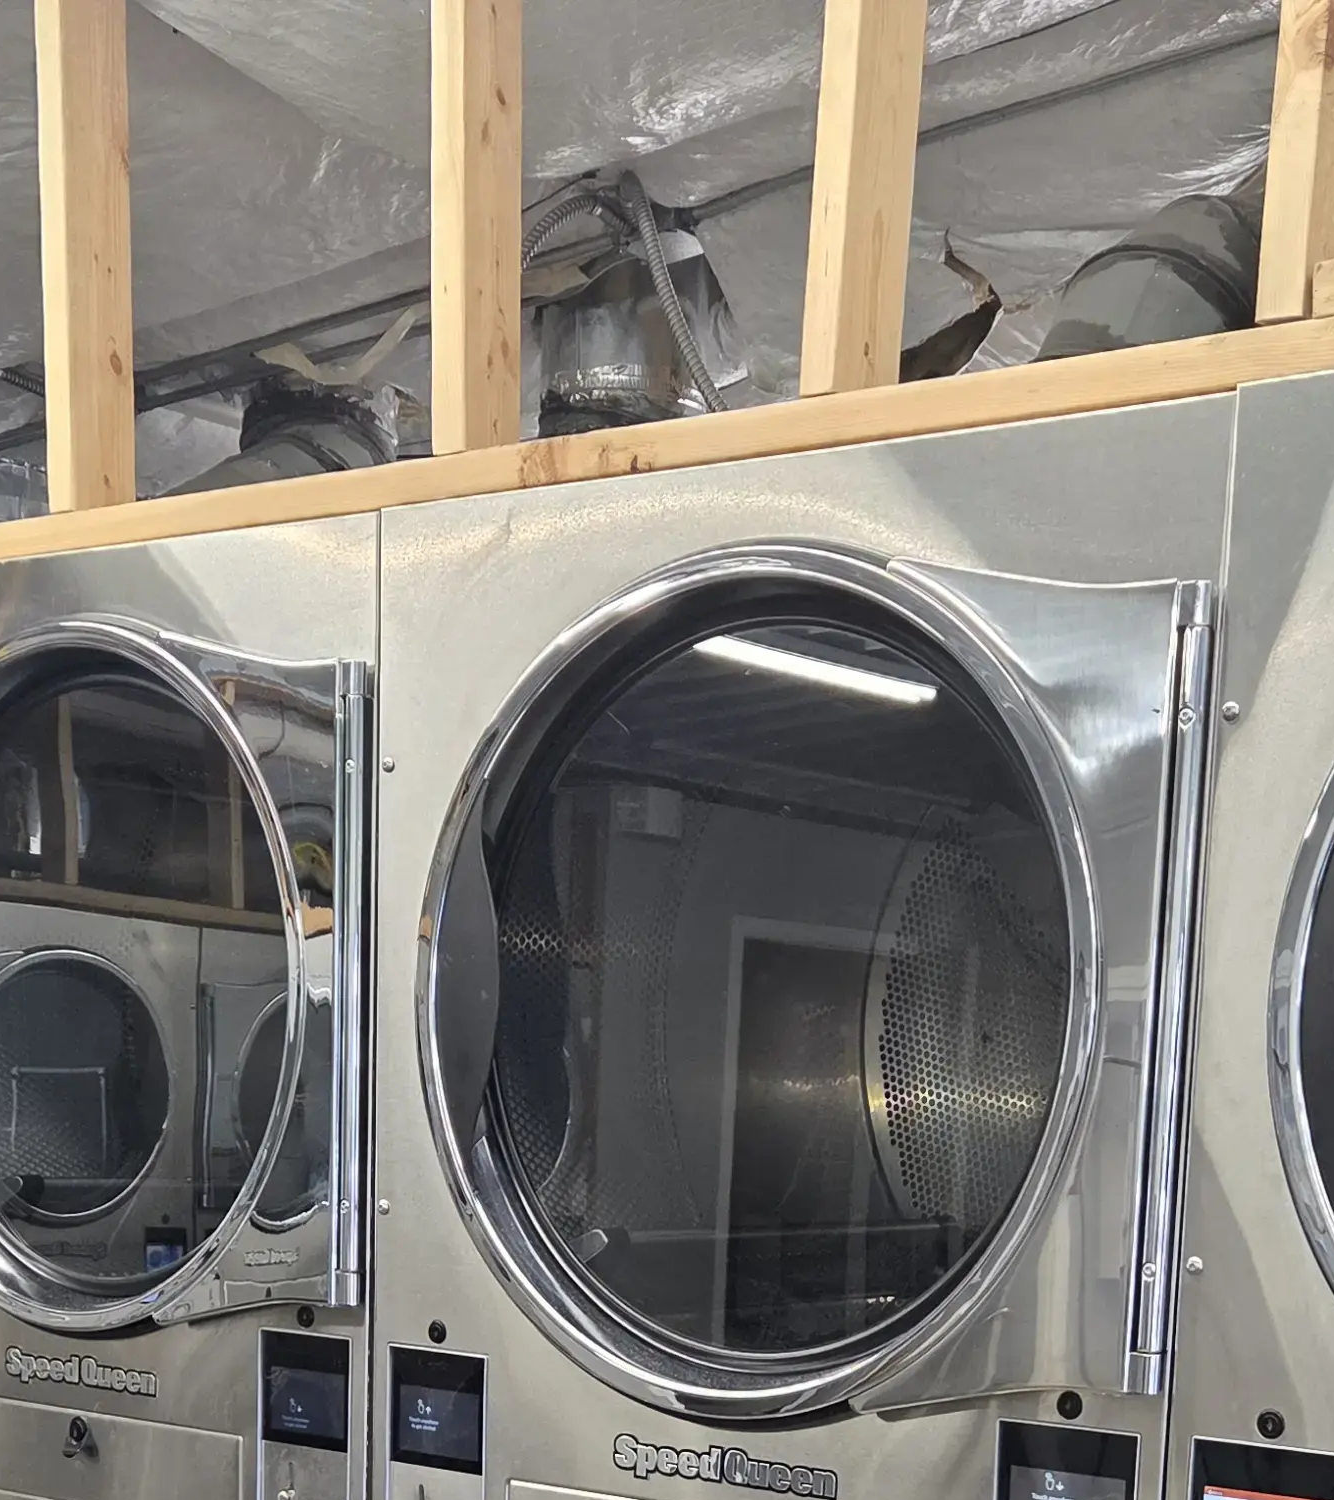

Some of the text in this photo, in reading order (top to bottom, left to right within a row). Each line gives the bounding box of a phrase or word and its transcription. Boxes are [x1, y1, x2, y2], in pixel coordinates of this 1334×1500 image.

[5, 1345, 157, 1397] Speed Queen
[613, 1433, 838, 1500] Speed Queen
